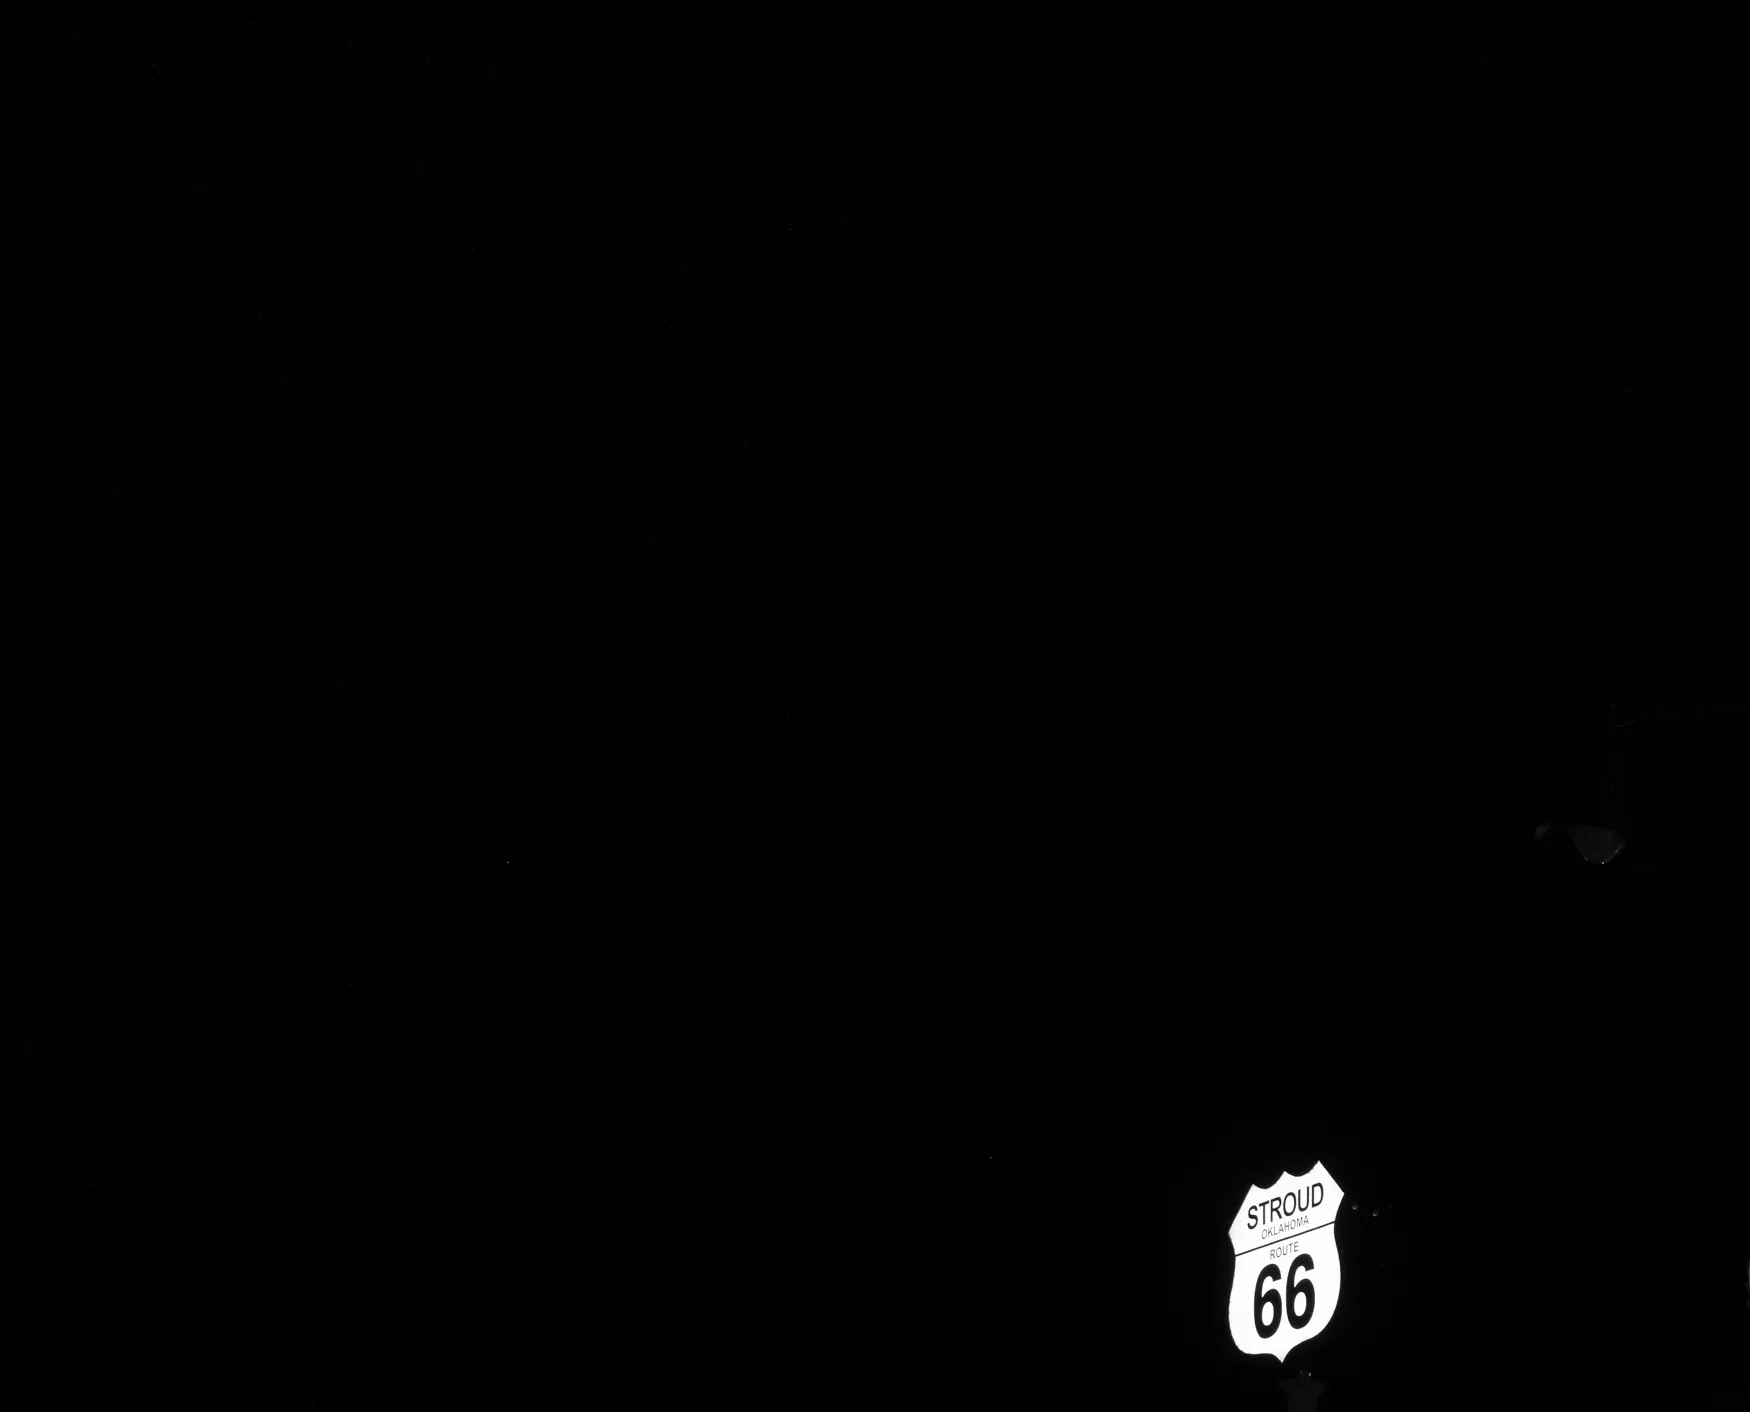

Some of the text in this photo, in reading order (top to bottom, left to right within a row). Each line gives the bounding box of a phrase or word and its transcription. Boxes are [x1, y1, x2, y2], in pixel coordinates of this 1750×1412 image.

[1247, 1182, 1324, 1230] STROUD
[1261, 1215, 1310, 1240] OKLAHOMA
[1269, 1241, 1300, 1260] ROUTE
[1253, 1253, 1316, 1339] 66
